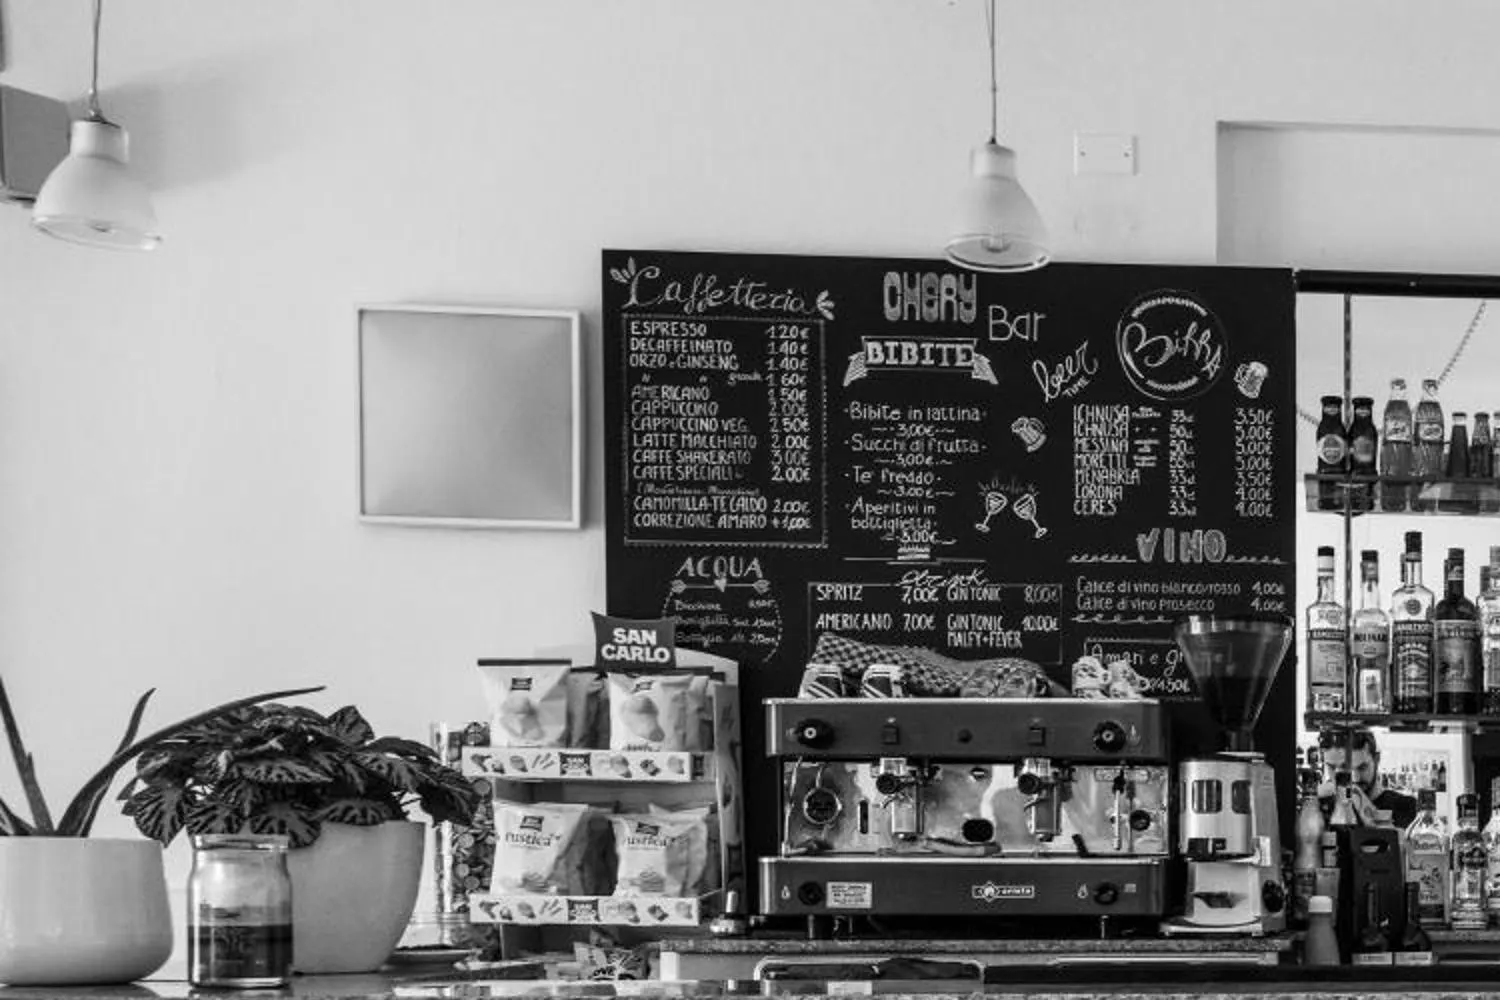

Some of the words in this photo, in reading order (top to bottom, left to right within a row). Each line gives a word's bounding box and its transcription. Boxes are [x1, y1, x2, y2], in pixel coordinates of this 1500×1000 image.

[621, 264, 817, 315] Caffetteria
[630, 321, 707, 337] ESPRESSO
[988, 304, 1046, 341] Bar
[629, 337, 733, 353] DECAFFEINATO
[629, 353, 667, 368] ORZO
[676, 353, 739, 370] GINSENG
[866, 341, 975, 367] BIBITE
[631, 385, 711, 401] AMERICANO
[631, 400, 719, 416] CAPPUCCINO
[851, 401, 901, 421] Bibite
[908, 406, 923, 421] in
[927, 406, 981, 421] lattina
[1073, 403, 1129, 422] ICHNUSA
[631, 416, 719, 432] CAPPUCCINO
[633, 433, 678, 448] LATTE
[681, 433, 757, 449] MACCHIATO
[851, 433, 906, 451] Succhi
[928, 438, 979, 453] frutta
[676, 449, 751, 465] SHAKERATO
[676, 465, 733, 481] SPECIALI
[881, 467, 934, 485] freddo
[851, 496, 919, 521] Aperitivi
[923, 503, 936, 514] in
[1073, 500, 1117, 515] CERES
[633, 513, 715, 528] CORREZIONE
[718, 514, 768, 529] AMARO
[1136, 527, 1228, 563] VINO
[675, 556, 764, 579] ACQUA
[816, 585, 864, 601] SPRITZ
[1077, 576, 1115, 593] Calice
[815, 613, 893, 630] AMERICANO
[612, 627, 657, 646] SAN
[600, 643, 671, 664] CARLO
[1149, 653, 1159, 664] e
